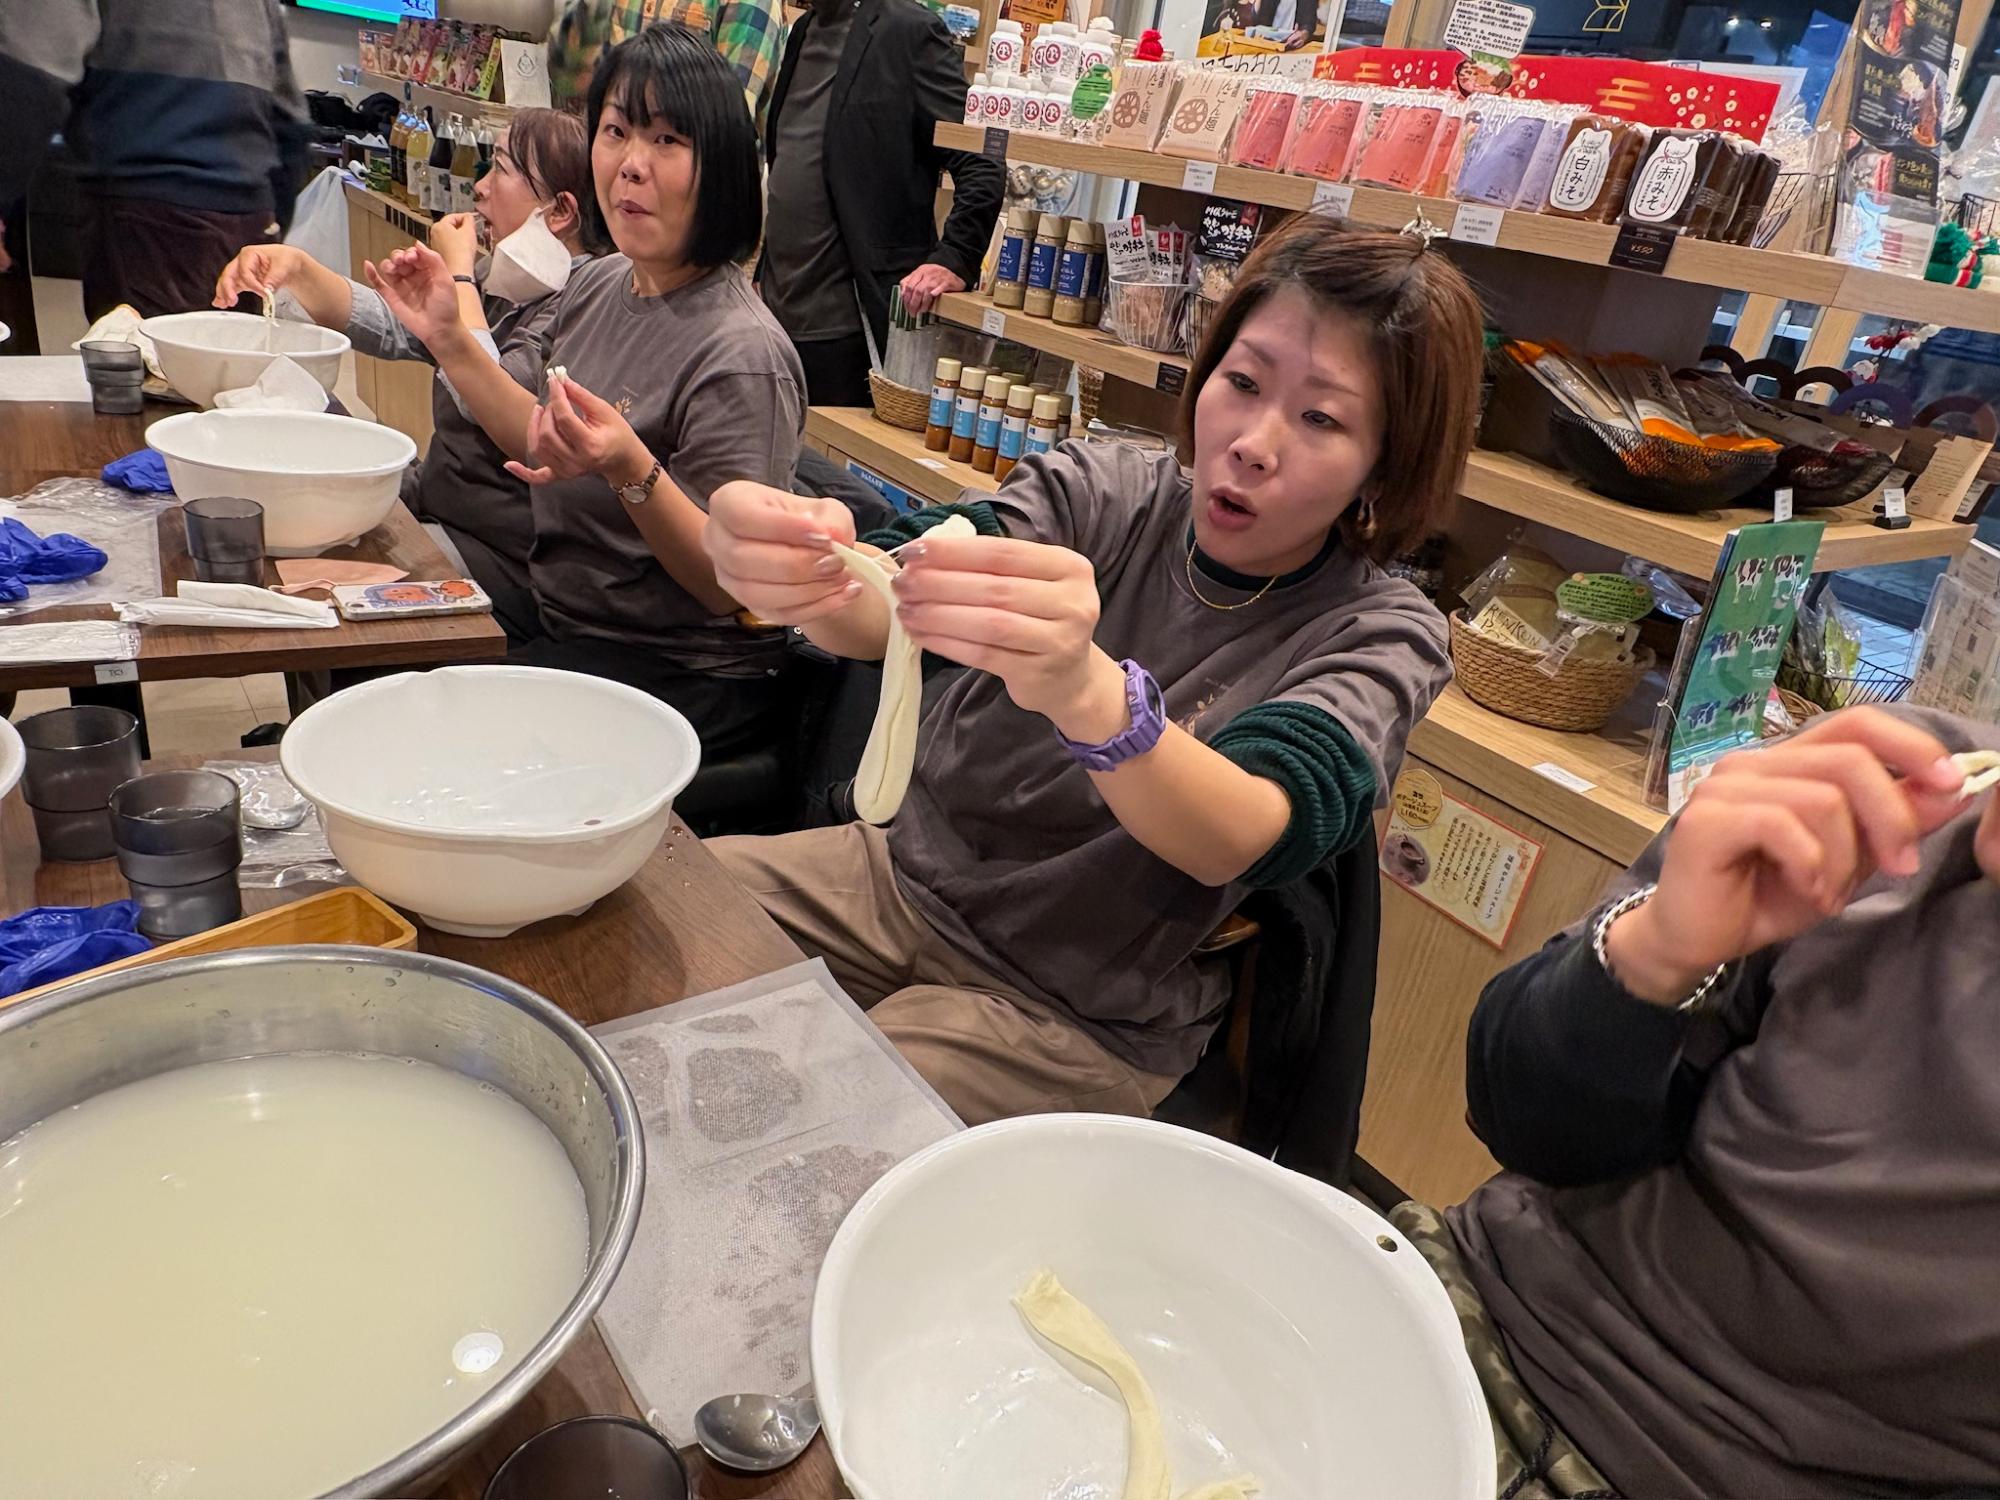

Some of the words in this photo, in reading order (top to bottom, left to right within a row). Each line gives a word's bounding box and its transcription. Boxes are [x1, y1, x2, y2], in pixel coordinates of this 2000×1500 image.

[1565, 155, 1590, 200] 白みそ
[1646, 167, 1674, 211] 赤みそ
